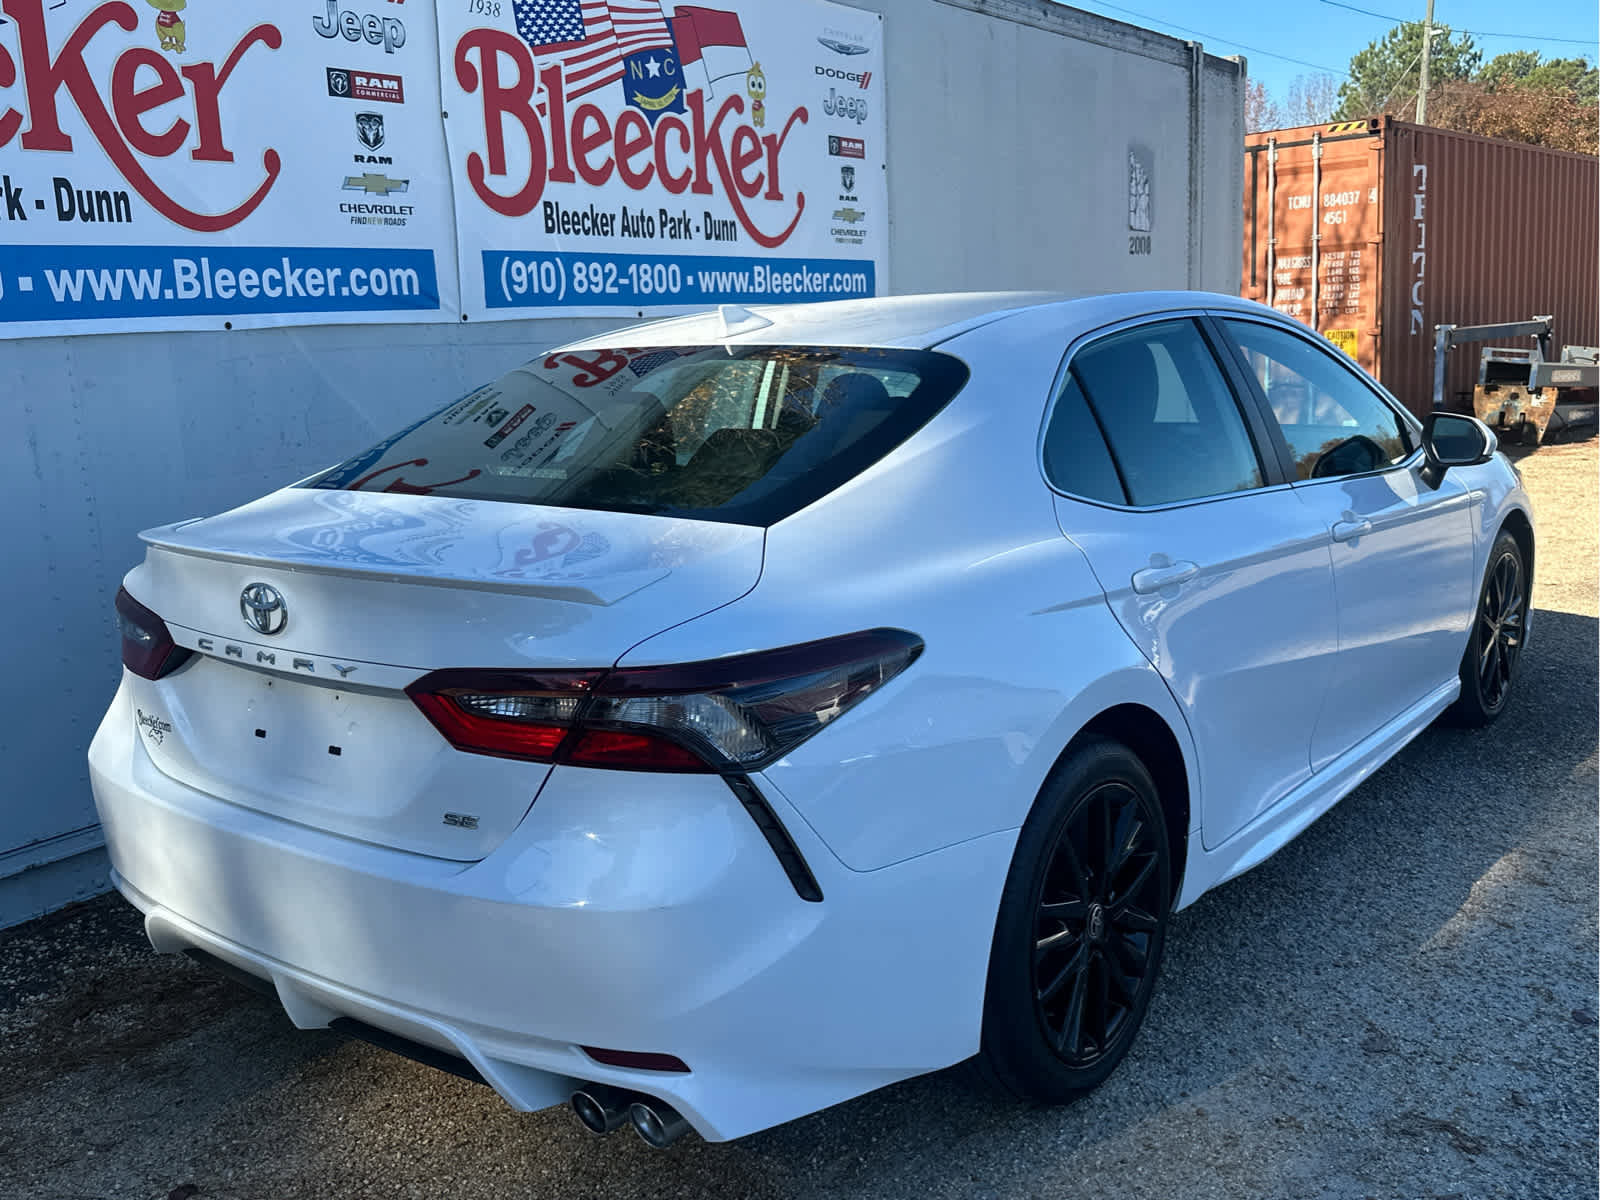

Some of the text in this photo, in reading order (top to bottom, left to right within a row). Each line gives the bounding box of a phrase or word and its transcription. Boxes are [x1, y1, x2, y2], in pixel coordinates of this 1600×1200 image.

[468, 0, 501, 18] 1938
[313, 0, 406, 54] Jeep
[630, 58, 676, 80] N C
[815, 65, 865, 83] DODGE
[355, 76, 399, 90] RAM
[356, 89, 400, 100] COMMERCIAL
[823, 87, 868, 125] Jeep
[354, 154, 393, 165] RAM
[52, 176, 133, 223] Dunn
[1323, 190, 1360, 208] 884037
[339, 203, 415, 216] CHEVROLET
[543, 200, 737, 242] Bleecker Auto Park Dunn
[44, 255, 420, 302] www.Bleecker.com
[501, 256, 867, 302] (910) 892-1800 www.Bleecker.com
[198, 638, 358, 678] CAMRY
[442, 812, 480, 830] SE
